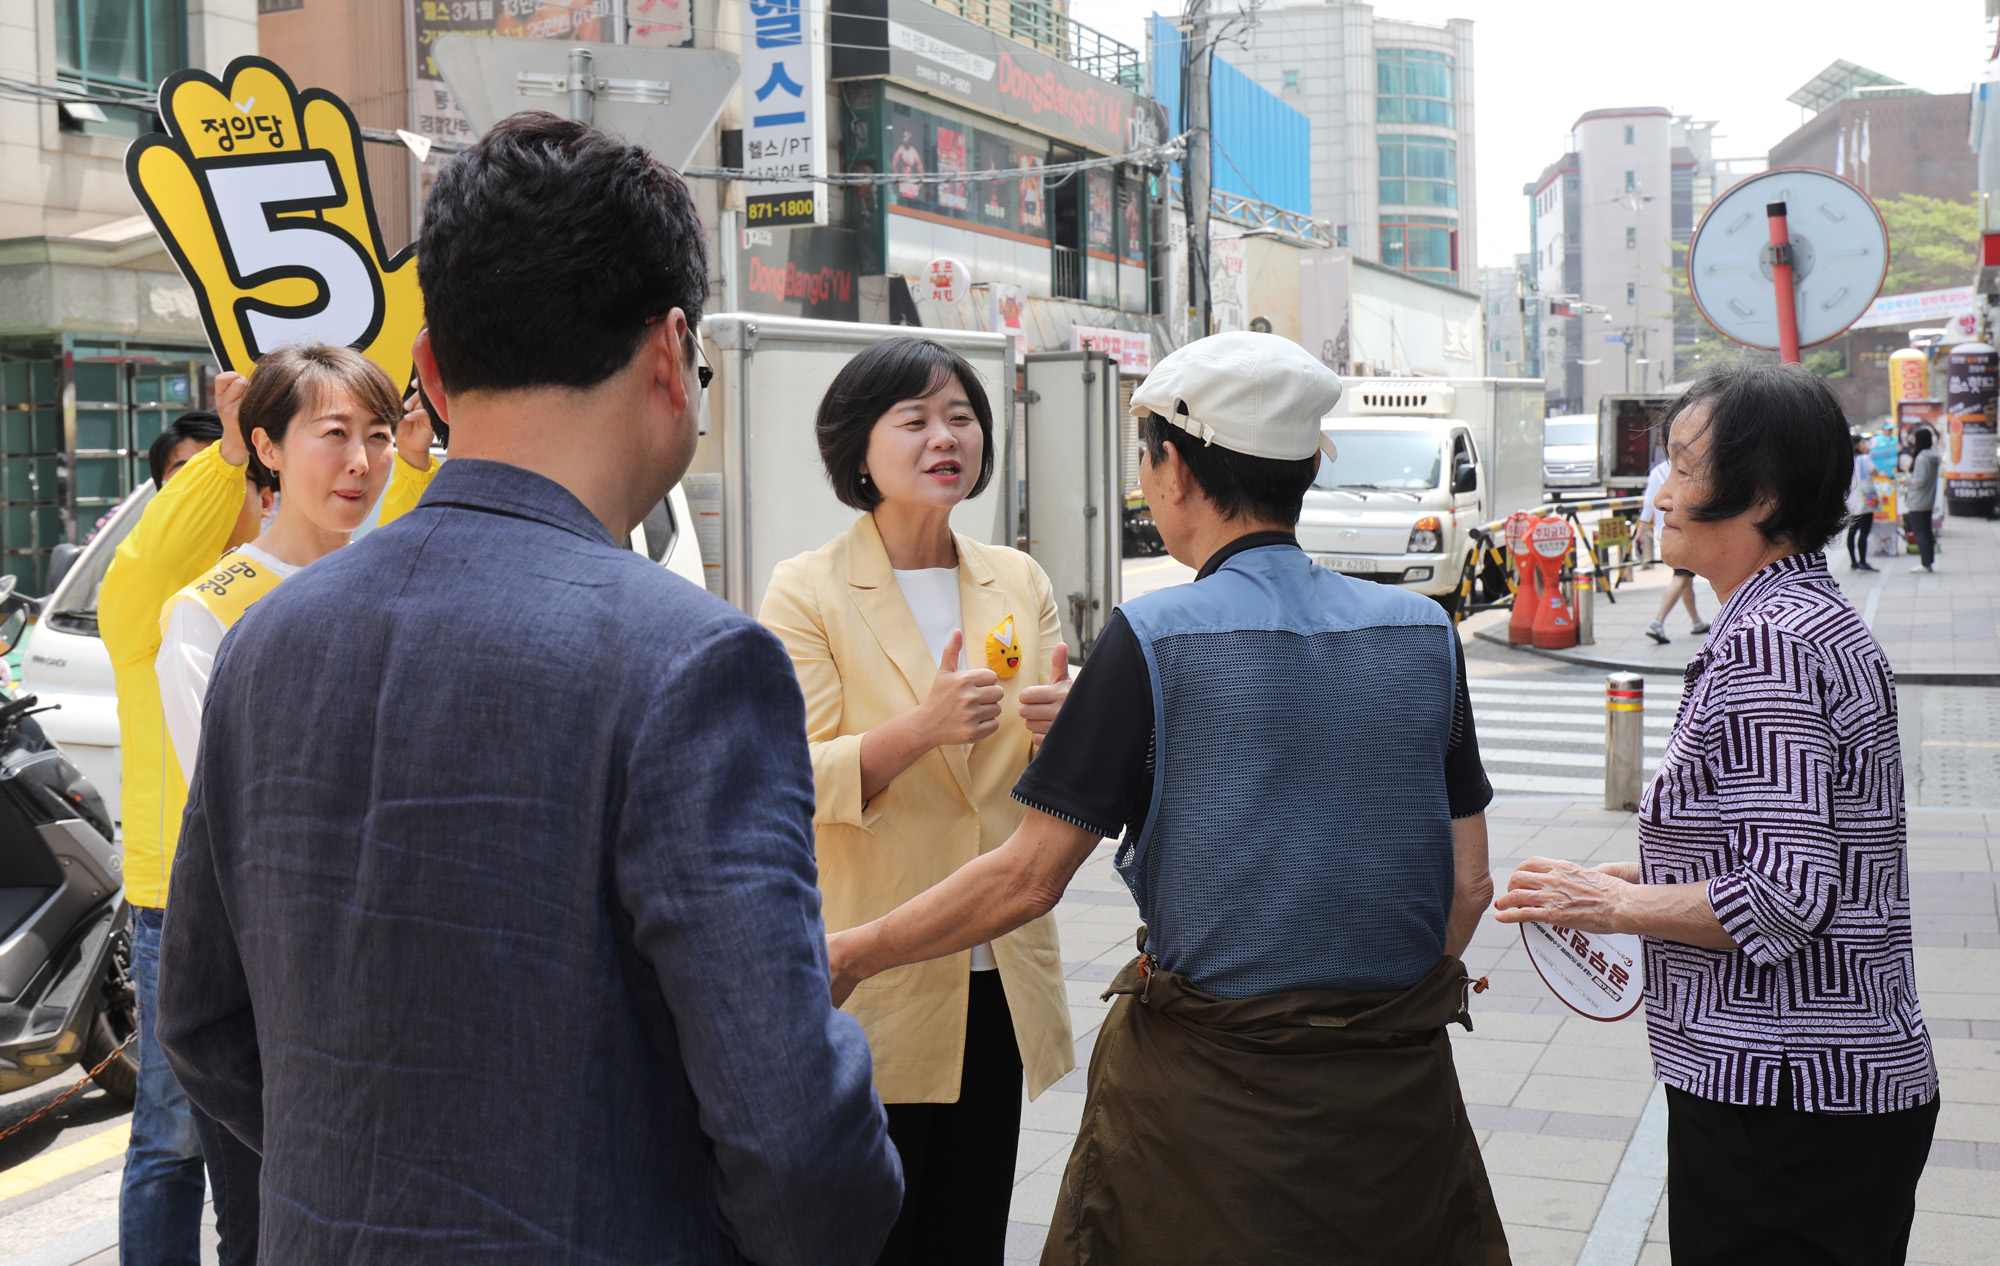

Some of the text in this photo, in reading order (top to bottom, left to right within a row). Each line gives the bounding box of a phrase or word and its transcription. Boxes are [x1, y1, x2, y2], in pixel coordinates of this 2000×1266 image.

[201, 115, 285, 152] 정의당
[748, 137, 812, 160] 헬스/PT
[748, 198, 814, 220] 871-1800
[205, 160, 375, 353] 5
[932, 290, 953, 302] 치킨
[1535, 526, 1567, 539] 주차금지
[195, 561, 257, 596] 정의당
[1544, 922, 1631, 992] 공무원과
